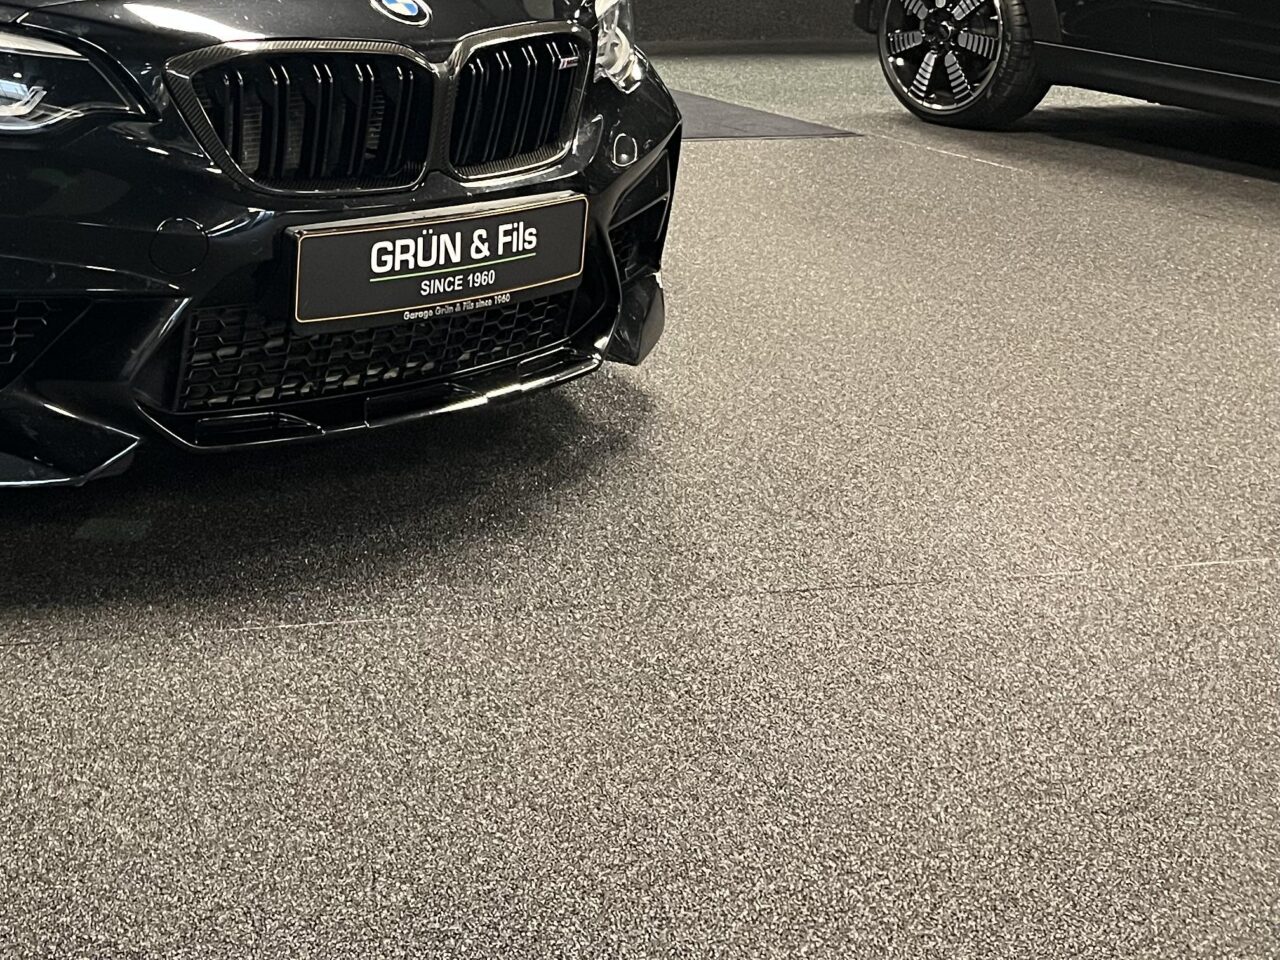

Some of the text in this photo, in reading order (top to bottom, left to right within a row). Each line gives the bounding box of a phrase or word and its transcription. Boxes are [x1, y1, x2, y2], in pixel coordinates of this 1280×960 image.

[370, 221, 537, 274] GRÜN & Fils
[420, 269, 495, 296] SINCE 1960
[403, 309, 433, 321] Garage
[475, 298, 492, 309] since
[494, 293, 511, 305] 1960
